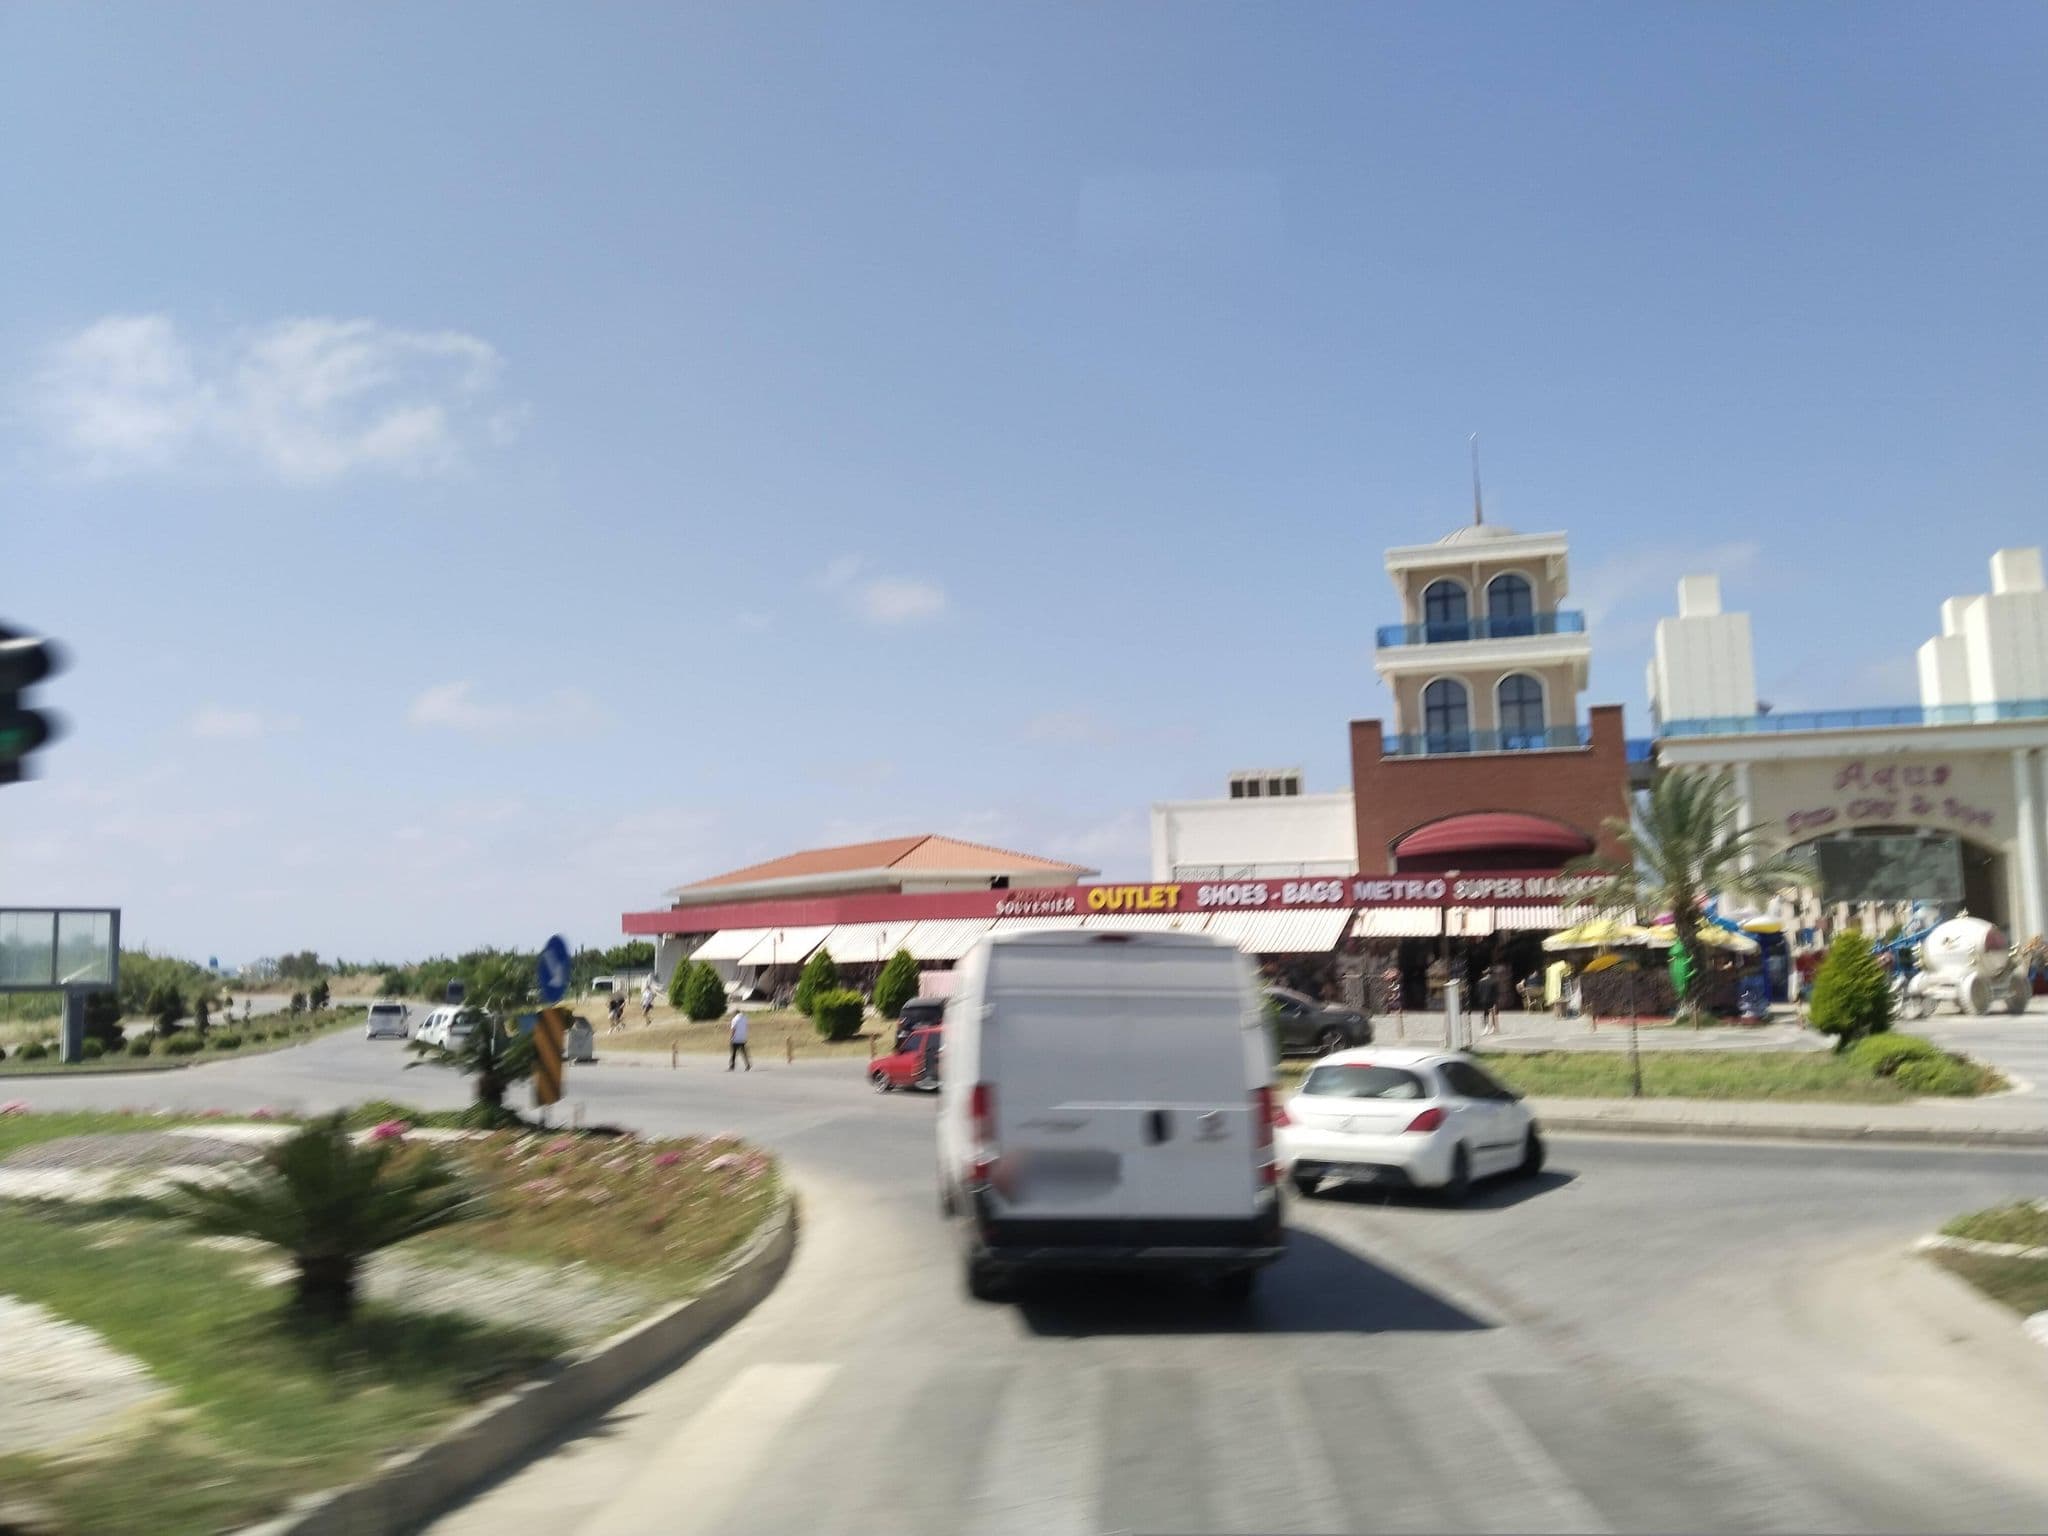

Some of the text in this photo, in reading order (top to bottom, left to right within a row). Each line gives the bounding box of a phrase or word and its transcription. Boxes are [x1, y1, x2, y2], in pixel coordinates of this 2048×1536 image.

[1087, 885, 1181, 910] OUTLET
[1197, 884, 1268, 907] SHOES
[1282, 881, 1344, 905] BAGS
[1353, 879, 1447, 900] METRO
[1453, 878, 1524, 899] SUPER
